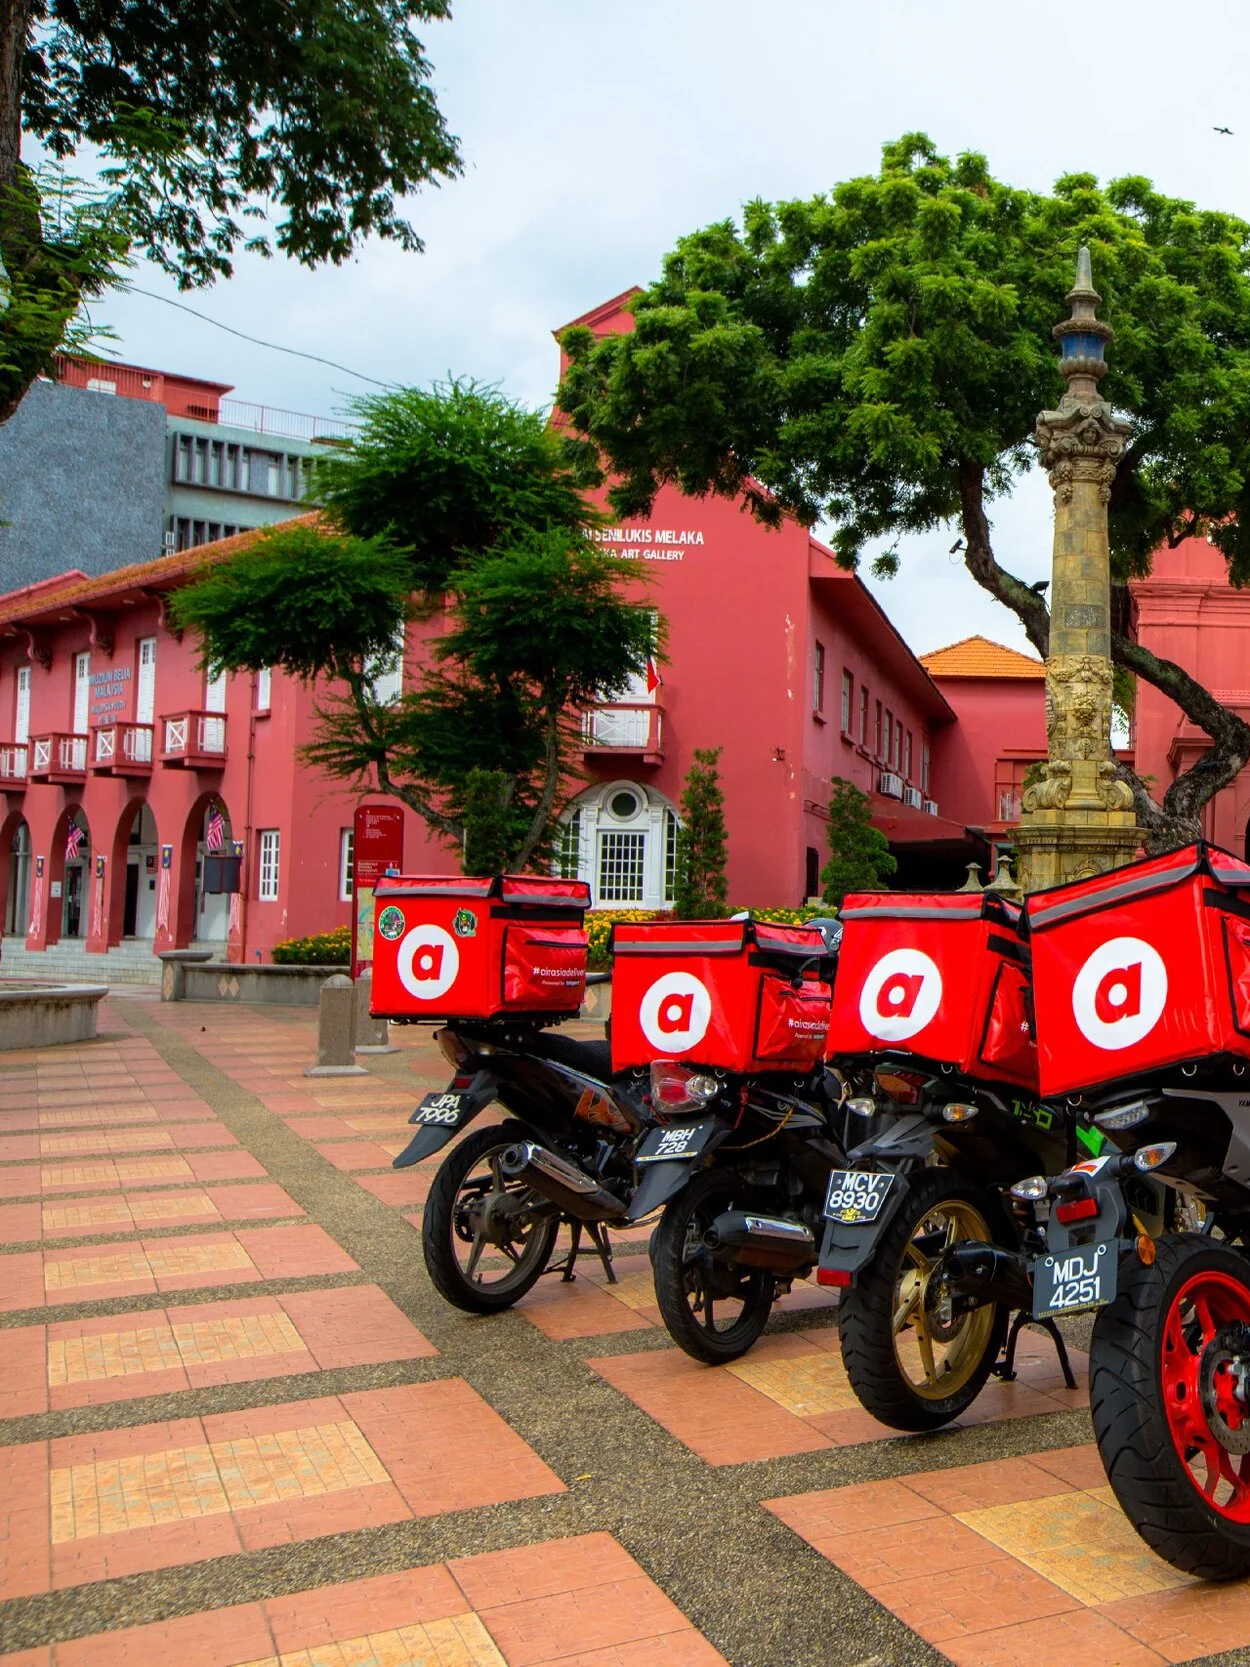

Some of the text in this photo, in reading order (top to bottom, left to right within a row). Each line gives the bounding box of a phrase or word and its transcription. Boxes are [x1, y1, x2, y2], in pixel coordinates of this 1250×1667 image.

[655, 529, 704, 545] MELAKA
[621, 549, 641, 559] ART
[643, 549, 685, 561] GALLERY
[411, 944, 444, 981] a
[876, 972, 925, 1018] a
[1095, 961, 1142, 1024] a
[657, 993, 694, 1034] a
[431, 1094, 461, 1108] JPA
[415, 1106, 460, 1123] 7996
[661, 1128, 696, 1142] MBH
[655, 1140, 688, 1155] 728
[842, 1173, 881, 1192] MCV
[829, 1190, 880, 1210] 8930
[1052, 1252, 1099, 1285] MDJ
[1049, 1276, 1101, 1308] 4251
